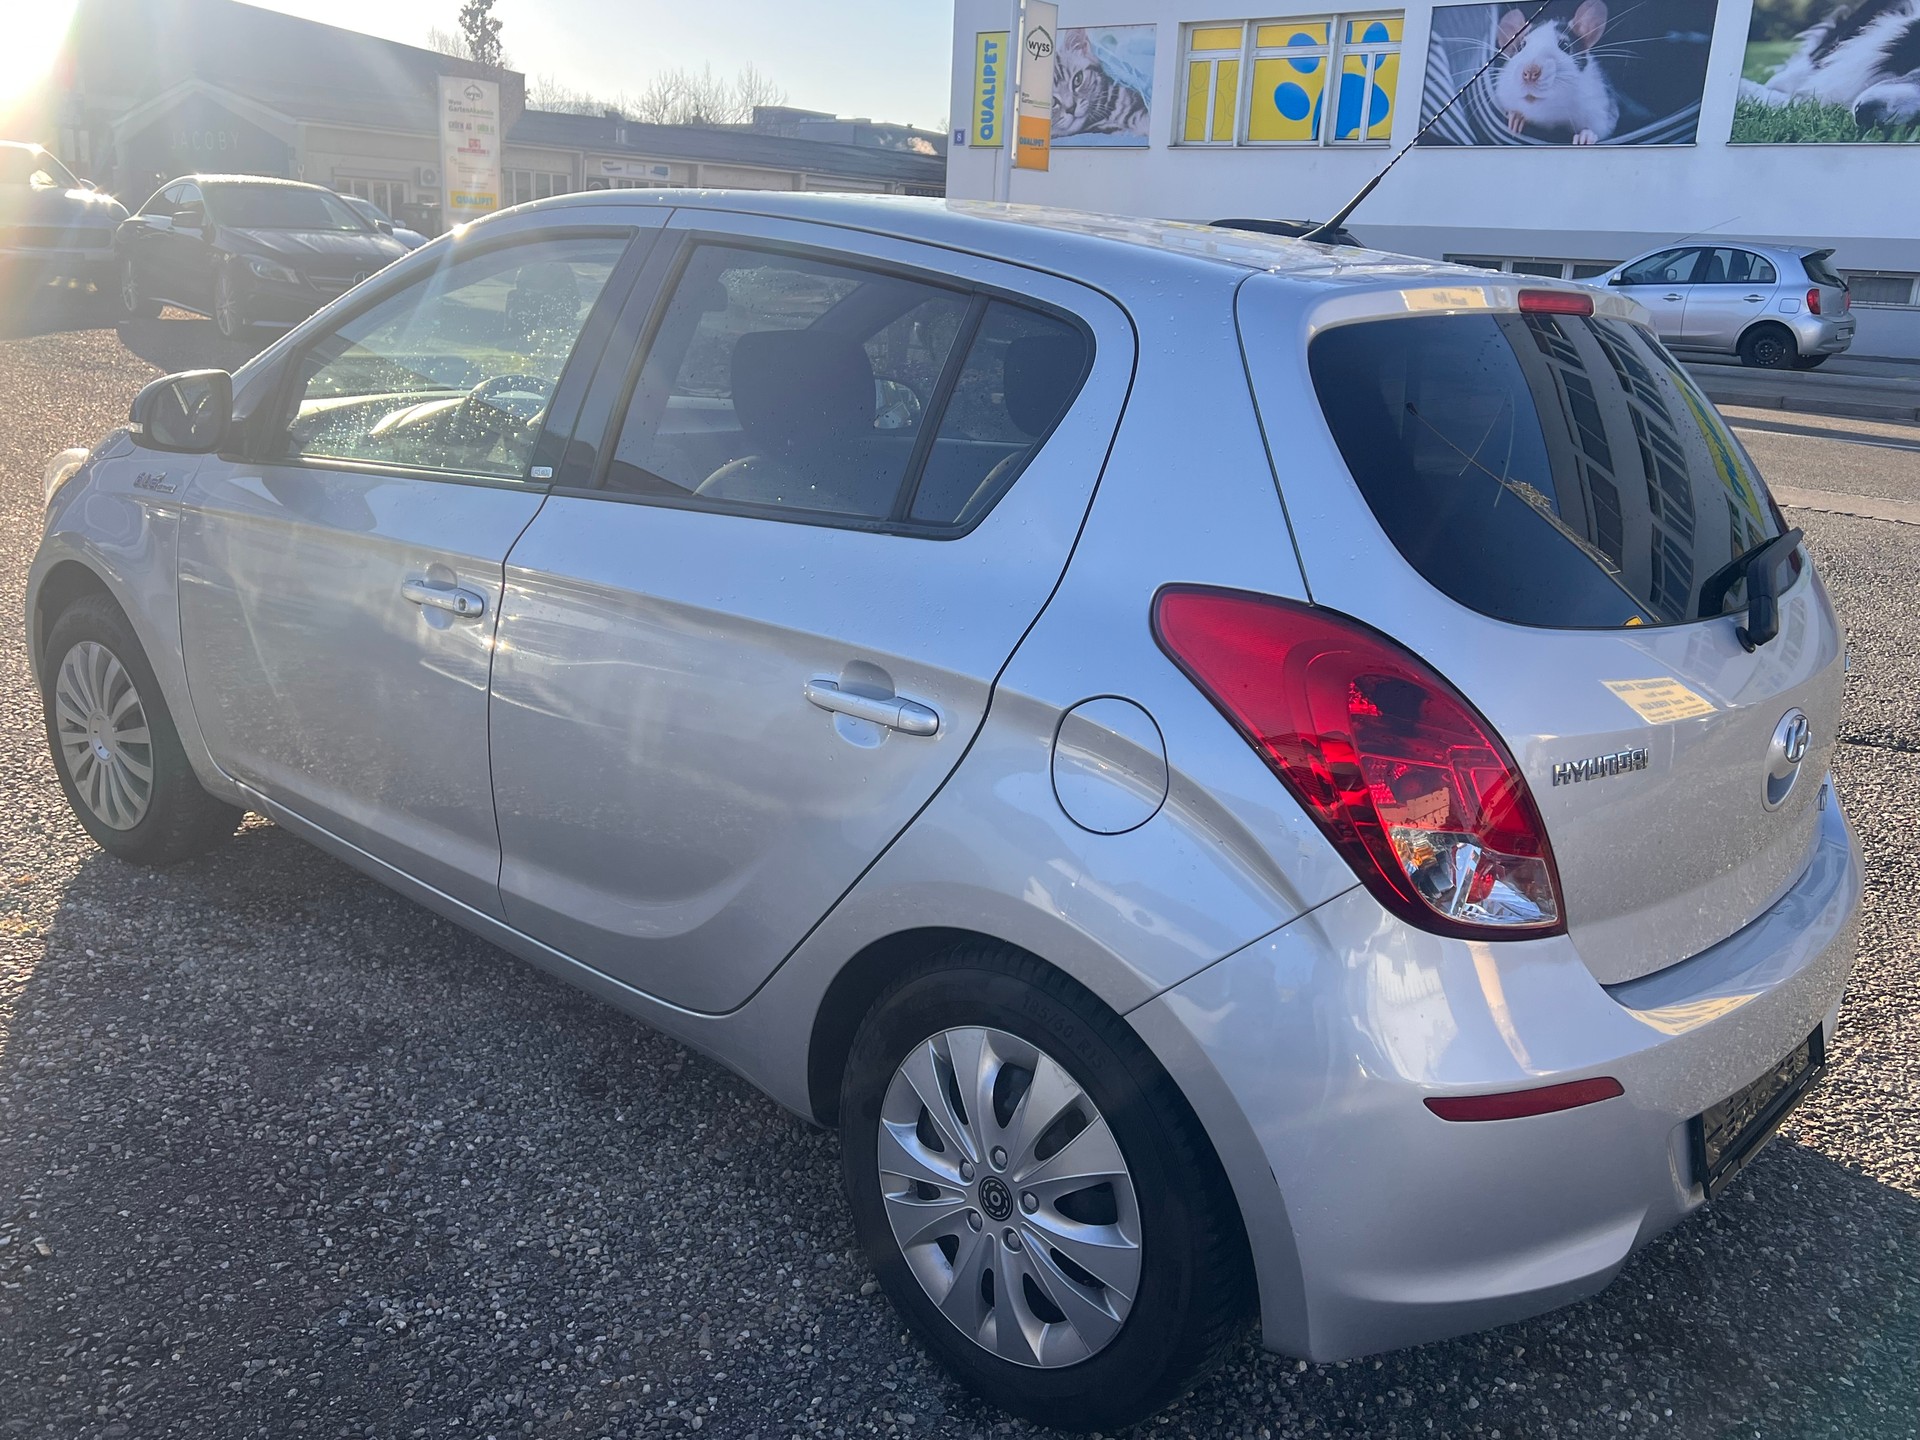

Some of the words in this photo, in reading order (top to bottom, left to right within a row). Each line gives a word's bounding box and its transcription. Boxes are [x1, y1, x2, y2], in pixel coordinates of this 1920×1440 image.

[1028, 40, 1050, 61] wyss
[980, 40, 998, 140] QUALIPET
[170, 130, 240, 151] JACOBY
[456, 196, 493, 205] QUALIPET
[1552, 747, 1649, 787] HYUNDAI
